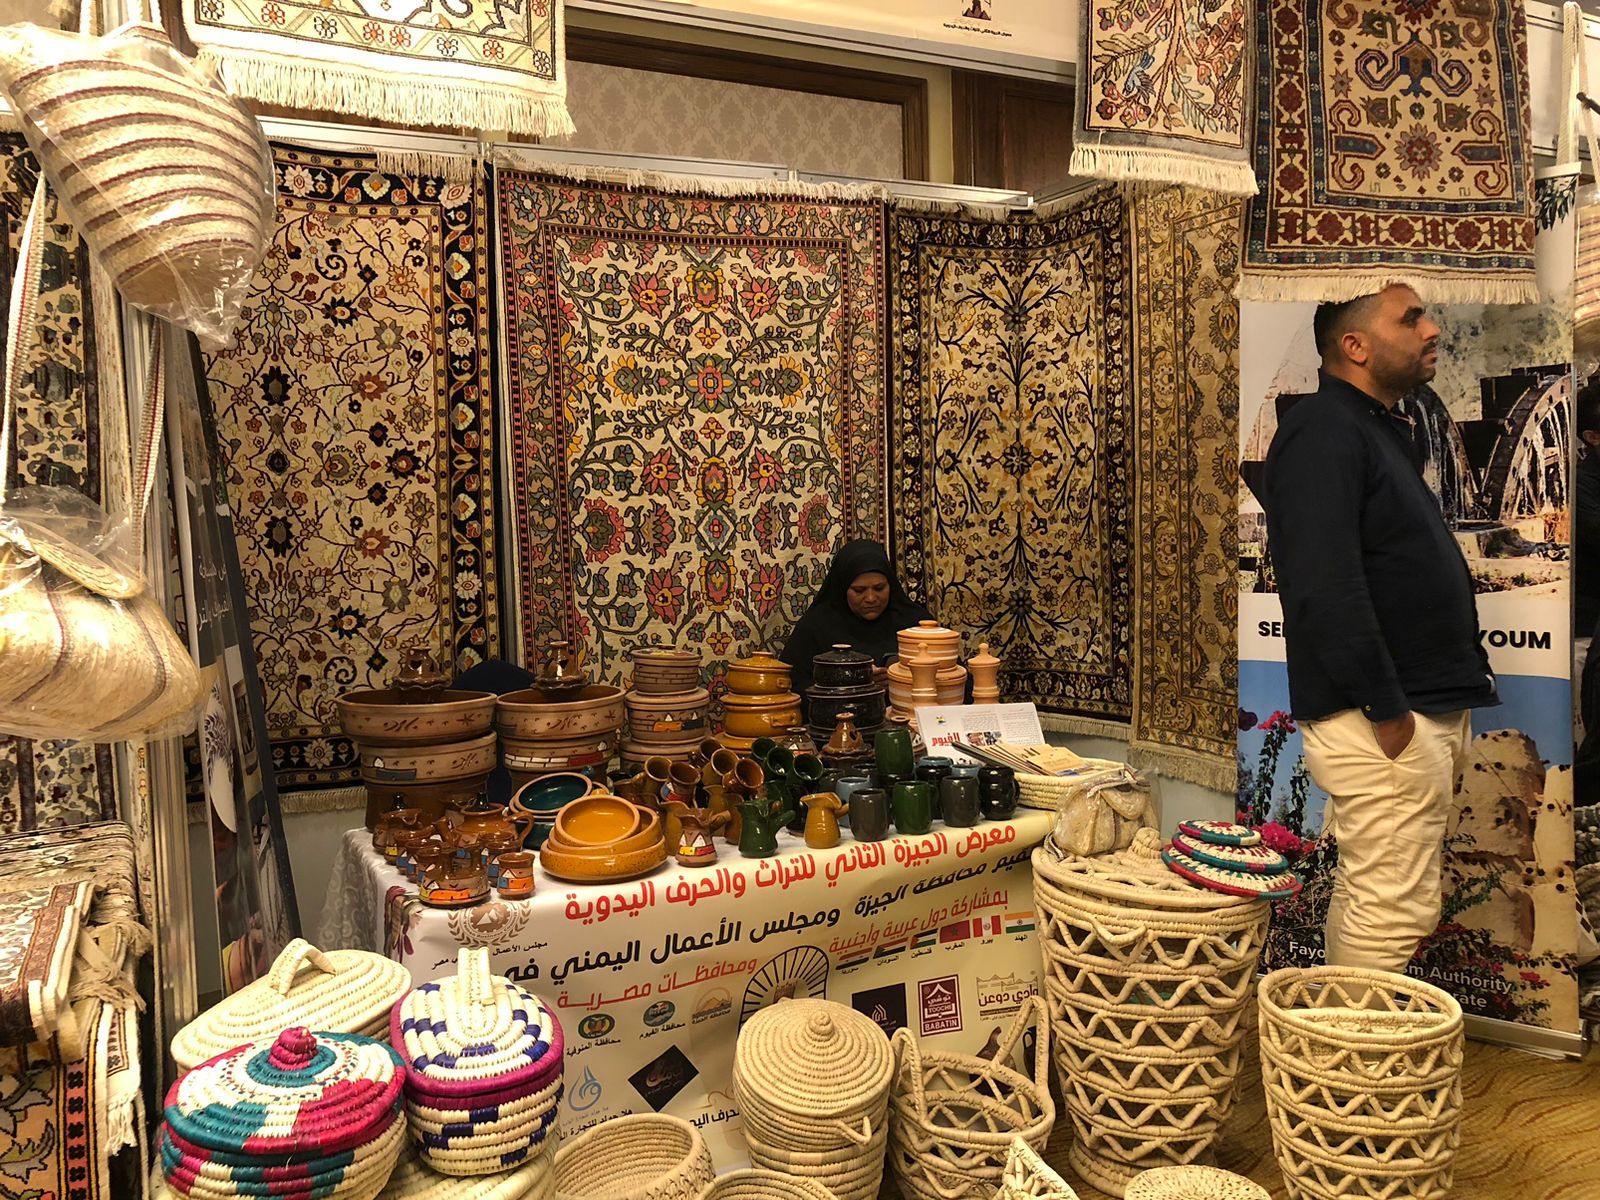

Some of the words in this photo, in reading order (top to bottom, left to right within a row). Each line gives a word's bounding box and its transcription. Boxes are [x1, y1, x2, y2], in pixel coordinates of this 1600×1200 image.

[1258, 620, 1285, 638] SE
[1478, 629, 1551, 650] YOUM
[893, 831, 948, 868] الجيزة
[956, 824, 1016, 858] معرض
[755, 853, 816, 890] للتراث
[825, 841, 886, 888] الثاني
[912, 862, 987, 895] محافظة
[665, 867, 746, 907] والحرف
[854, 883, 910, 918] الجيزة
[564, 881, 655, 925] اليدوية
[920, 905, 948, 931] دول
[950, 887, 1009, 919] بمشاركة
[749, 906, 841, 943] ومجلس
[828, 917, 880, 954] وأجنبية
[882, 915, 919, 941] عربية
[1013, 933, 1029, 942] الهند
[523, 941, 548, 952] مجلس
[649, 916, 742, 965] الأعمال
[910, 947, 933, 959] فلسطين
[944, 941, 966, 952] المغرب
[431, 958, 449, 970] مصر
[550, 939, 641, 985] اليمني
[876, 955, 900, 966] السودان
[1289, 941, 1326, 960] Fayo
[1429, 966, 1512, 994] Authority
[978, 992, 1010, 1007] دوعن
[639, 1027, 660, 1040] الفيوم
[661, 1022, 686, 1032] محافظة
[924, 1018, 958, 1031] BABATIN
[566, 1042, 593, 1057] المنوفية
[594, 1037, 621, 1047] محافظة
